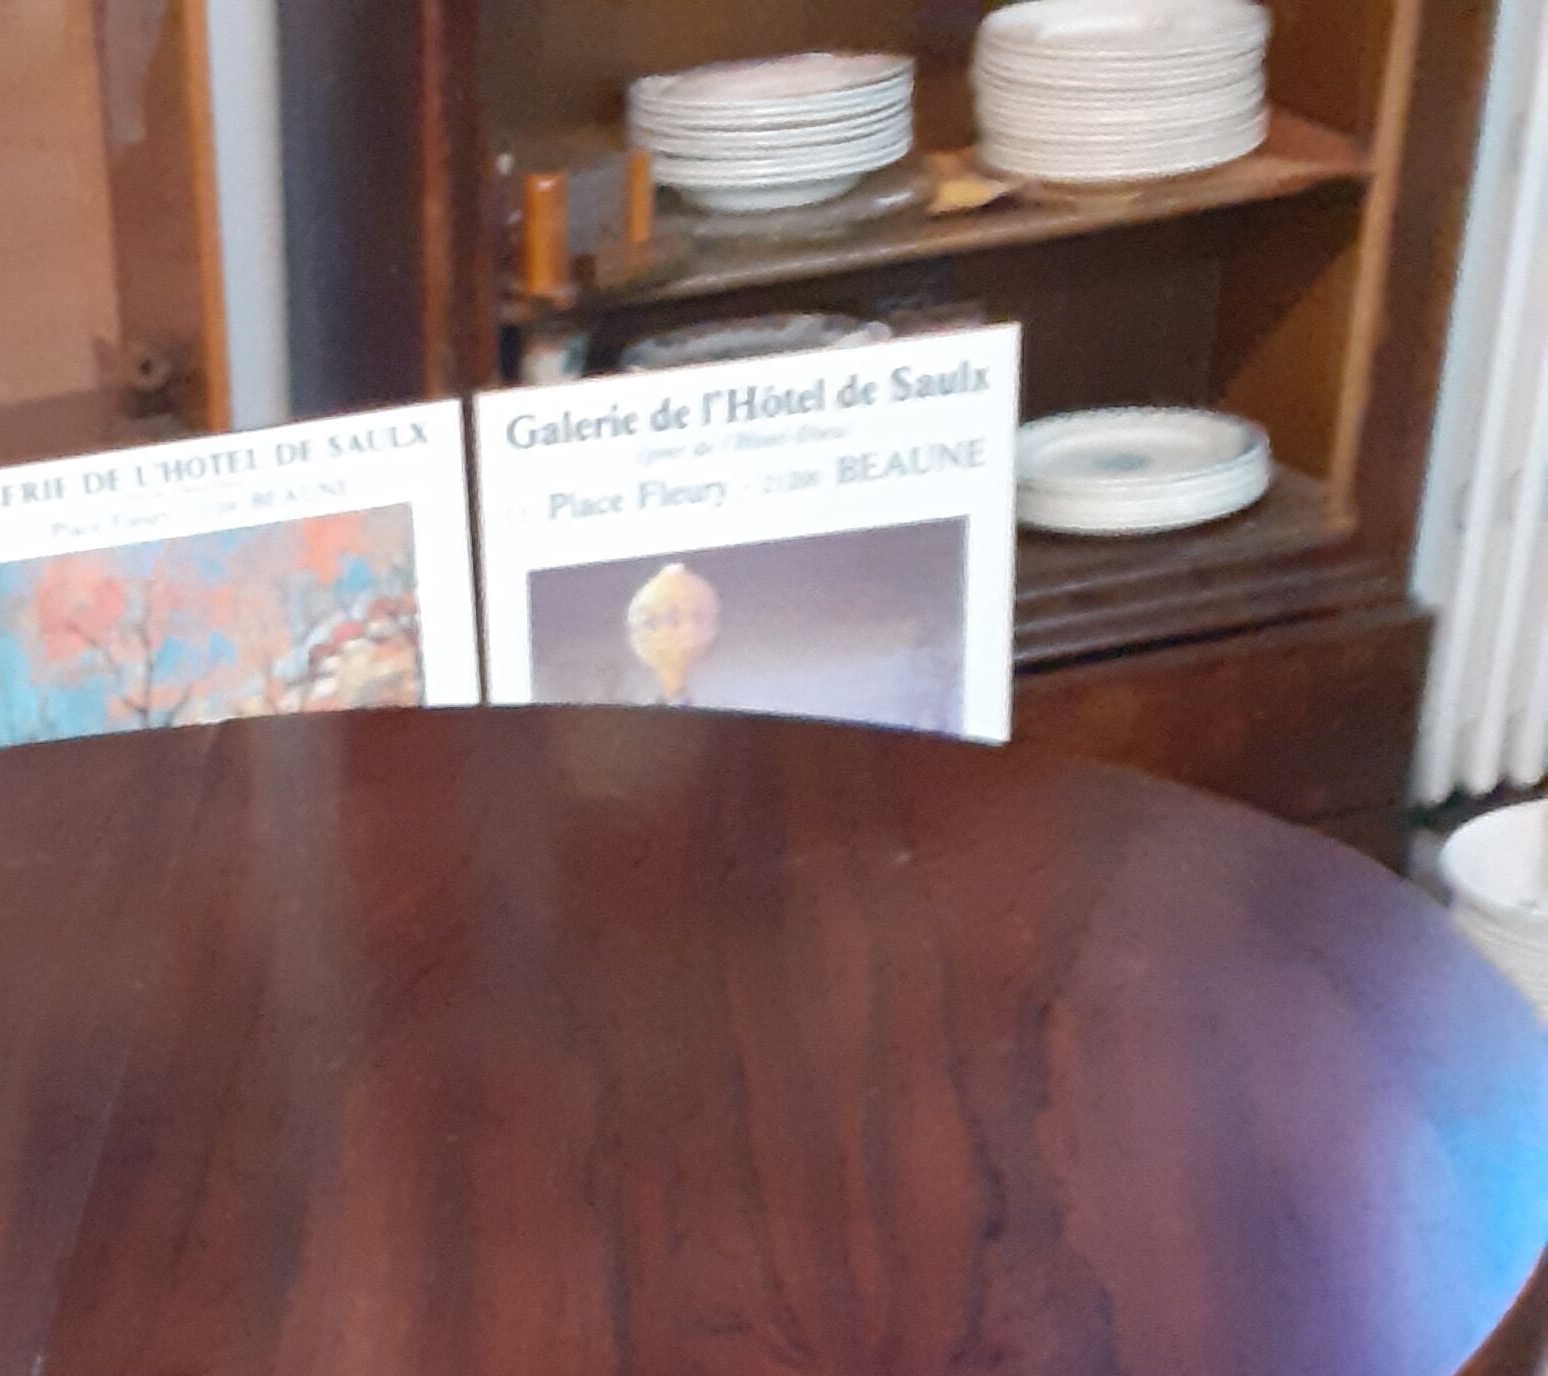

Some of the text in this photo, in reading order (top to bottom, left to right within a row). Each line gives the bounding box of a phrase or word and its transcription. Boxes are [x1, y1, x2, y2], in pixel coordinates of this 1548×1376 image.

[506, 403, 638, 450] Galerie
[650, 397, 690, 432] de
[836, 373, 879, 409] de
[890, 361, 991, 401] Saulx
[83, 468, 120, 497] DE
[276, 434, 314, 465] DE
[328, 421, 430, 458] SAULX
[836, 438, 988, 485] BEAUNE
